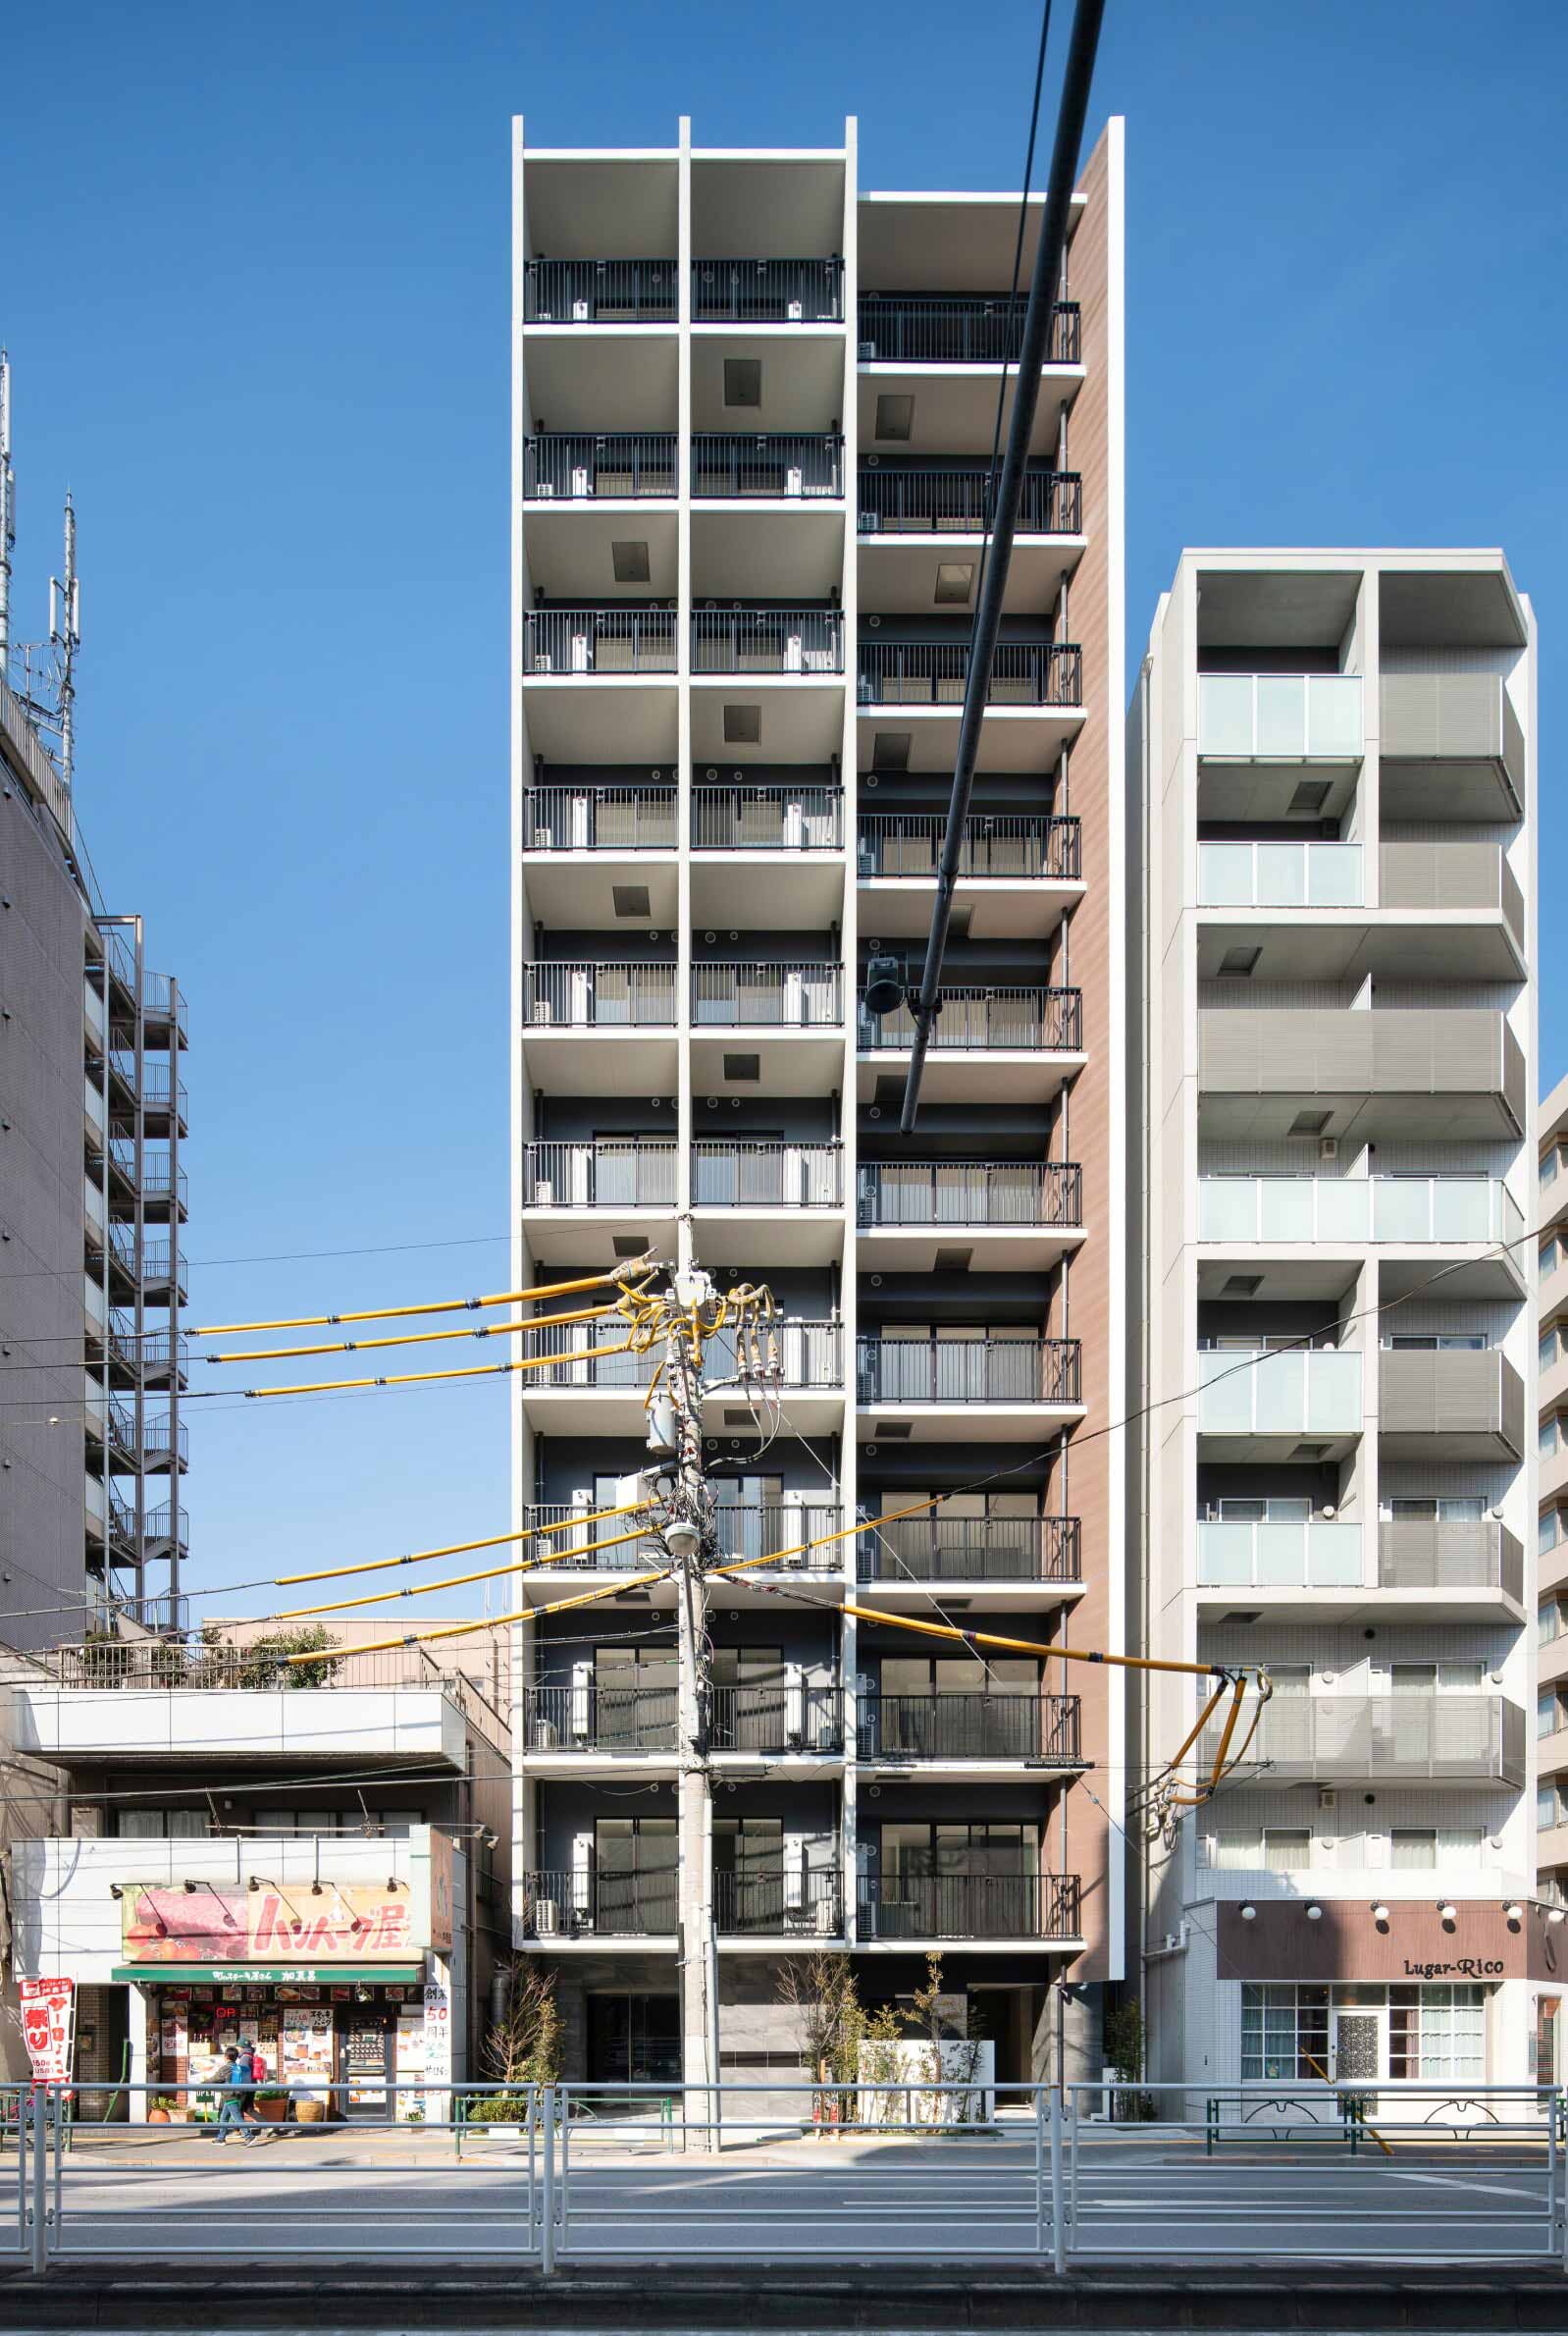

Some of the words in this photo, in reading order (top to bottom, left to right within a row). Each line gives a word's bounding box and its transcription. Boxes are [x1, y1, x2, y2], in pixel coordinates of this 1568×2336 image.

[1403, 1958, 1504, 1980] Lugar-Rico
[426, 2005, 447, 2021] 50
[26, 2008, 49, 2050] 祭り
